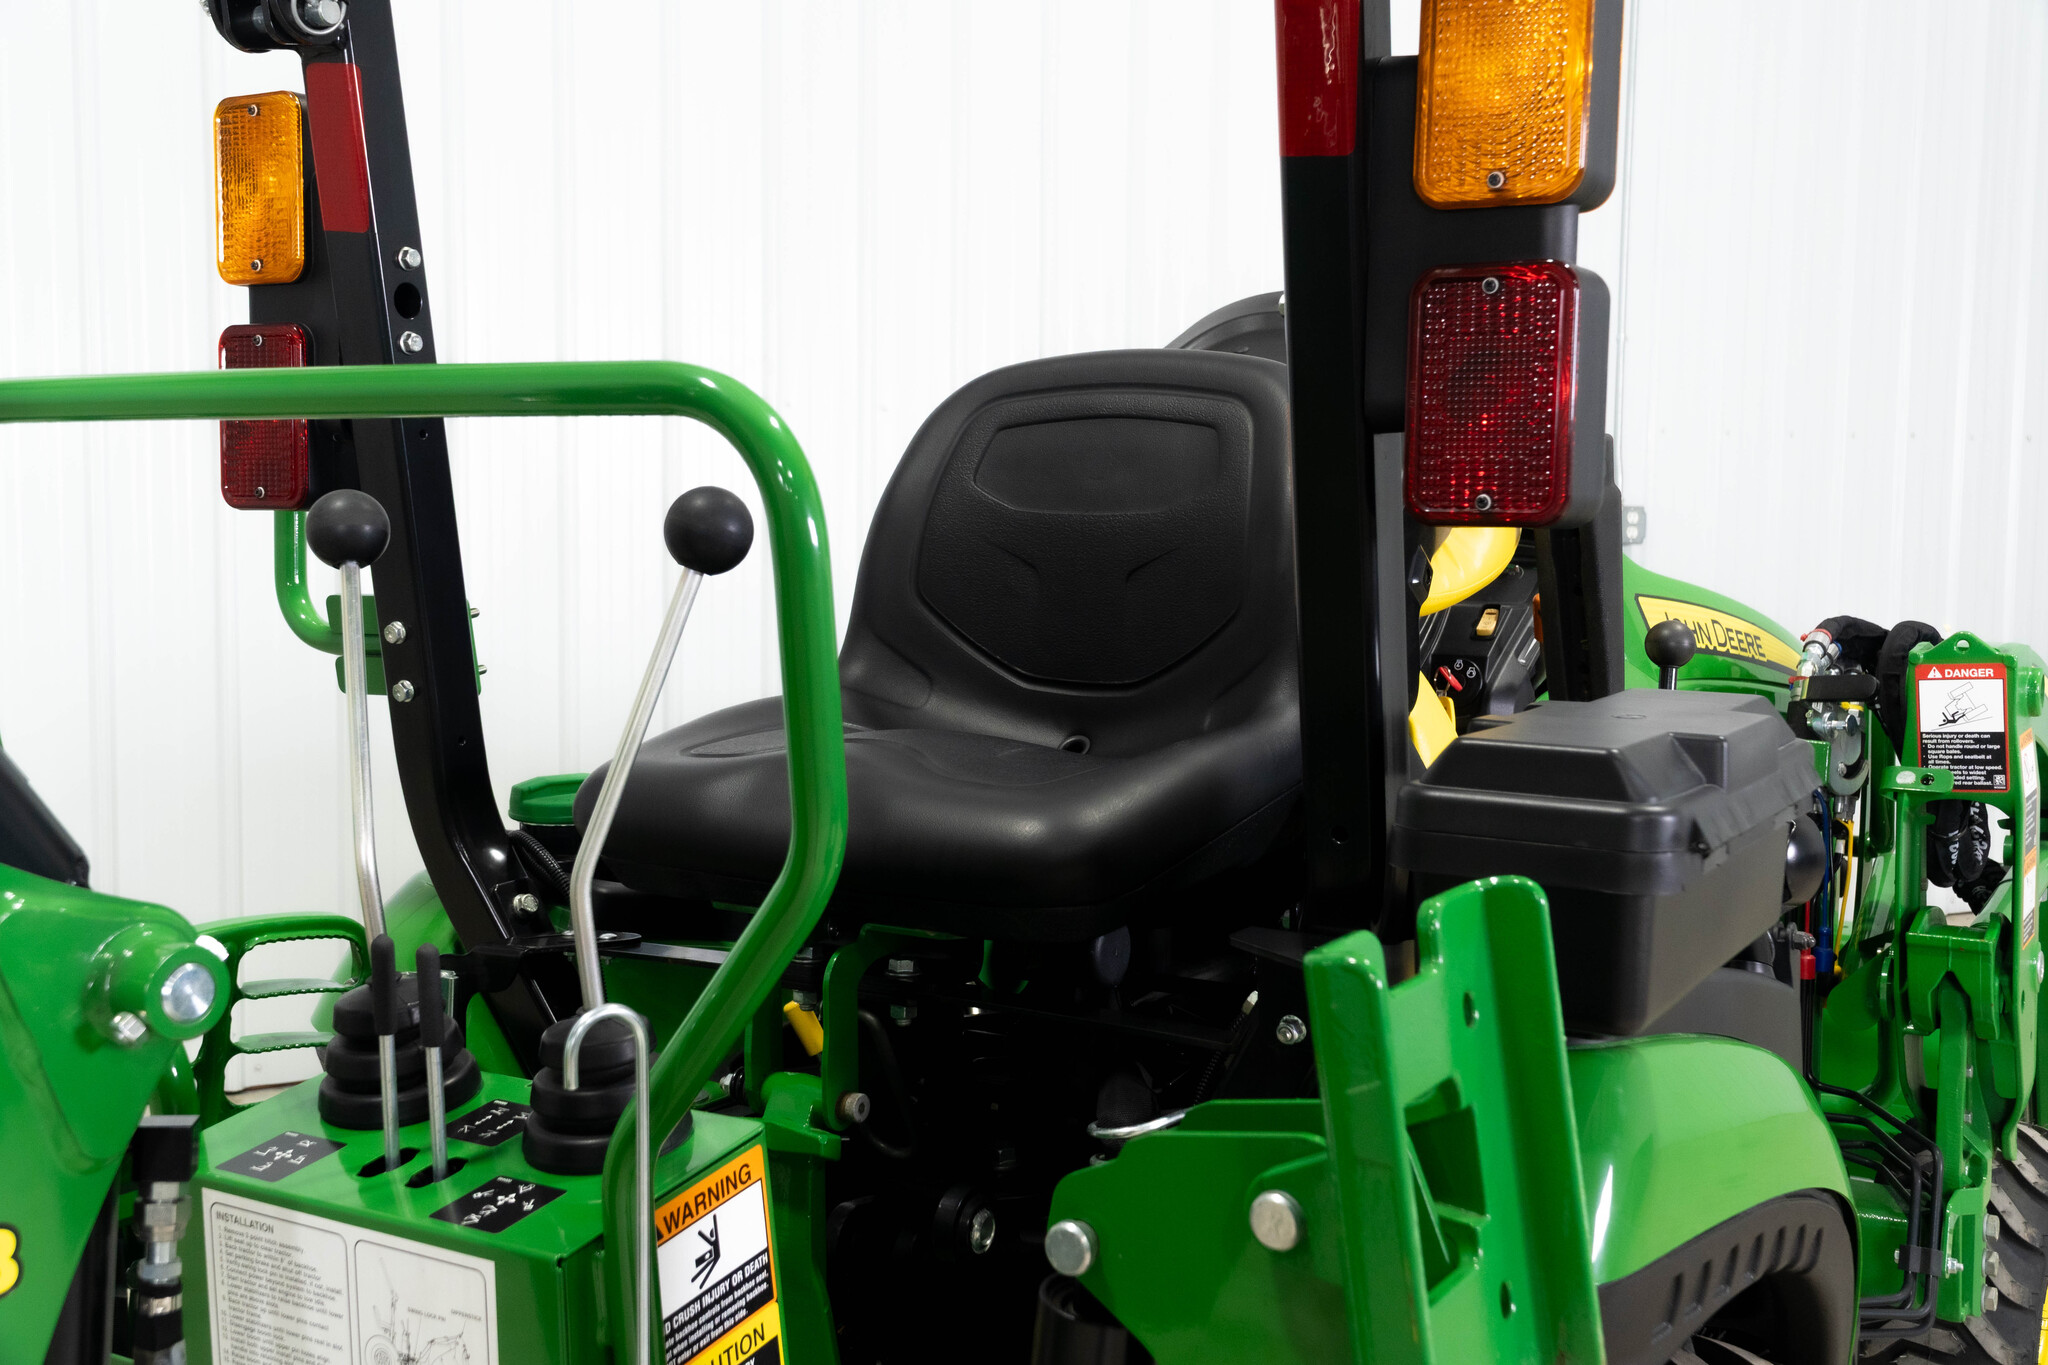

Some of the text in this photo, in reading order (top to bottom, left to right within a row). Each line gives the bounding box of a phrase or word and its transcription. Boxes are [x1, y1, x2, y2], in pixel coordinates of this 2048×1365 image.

[1712, 619, 1766, 658] DEERE
[1945, 669, 1994, 677] DANGER
[663, 1164, 752, 1234] WARNING
[216, 1210, 274, 1233] INSTALLATION
[673, 1300, 701, 1329] CRUSH
[702, 1279, 730, 1308] INJURY
[732, 1270, 743, 1287] OR
[745, 1252, 768, 1278] DEATH
[688, 1320, 714, 1344] installing
[715, 1315, 721, 1325] or
[721, 1297, 746, 1319] removing
[699, 1302, 720, 1325] controls
[721, 1296, 733, 1309] from
[692, 1341, 699, 1351] or
[711, 1323, 724, 1340] from
[724, 1317, 734, 1329] this
